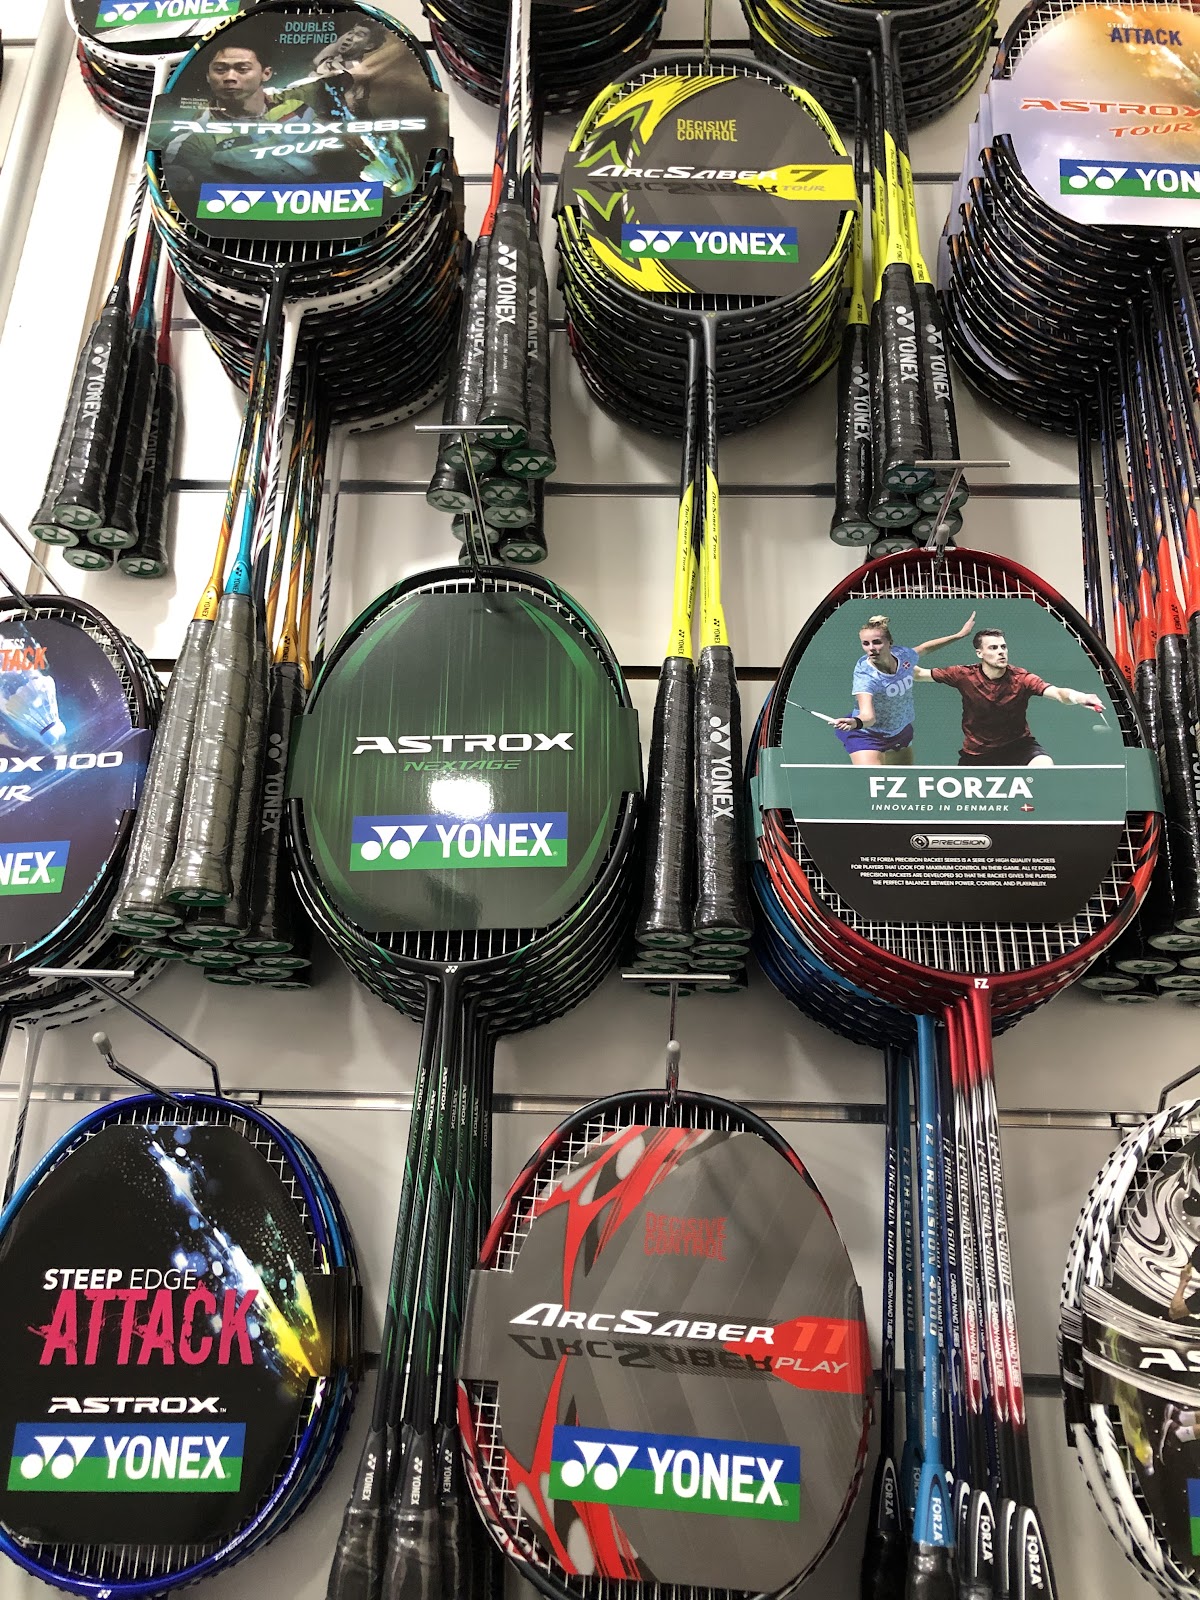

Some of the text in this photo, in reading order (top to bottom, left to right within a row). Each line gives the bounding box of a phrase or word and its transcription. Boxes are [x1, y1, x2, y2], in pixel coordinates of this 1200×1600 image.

[155, 0, 230, 18] YONEX
[279, 33, 338, 45] REDEFINED
[285, 21, 335, 32] DOUBLES
[1108, 27, 1183, 46] ATTACK
[170, 119, 340, 135] ASTROX
[676, 118, 737, 132] DECISIVE
[676, 129, 738, 142] CONTROL
[1109, 123, 1194, 138] TOUR
[250, 137, 345, 160] TOUR
[782, 184, 826, 193] TOUR
[789, 168, 829, 183] 7
[270, 187, 373, 215] YONEX
[690, 231, 788, 256] YONEX
[498, 278, 517, 326] YONEX
[898, 335, 920, 384] YONEX
[929, 354, 951, 402] YONEX
[82, 373, 106, 420] YONEX
[854, 395, 871, 441] YONEX
[1173, 614, 1182, 630] YONEX
[677, 638, 685, 655] YONEX
[351, 733, 575, 755] ASTROX
[54, 750, 124, 771] 100
[403, 760, 522, 772] NEXTAGE
[711, 755, 735, 820] YONEX
[869, 776, 908, 798] FZ
[261, 771, 285, 833] YONEX
[871, 804, 934, 812] INNOVATED
[956, 804, 1010, 812] DENMARK
[436, 823, 554, 859] YONEX
[974, 977, 989, 990] FZ
[417, 1067, 426, 1111] ASTROX
[440, 1067, 449, 1111] ASTROX
[888, 1165, 896, 1227] PRECISION
[943, 1137, 957, 1266] FZ PRECISION 6000
[645, 1211, 728, 1239] DECISIVE
[925, 1122, 938, 1337] FZ PRECISION 4000
[644, 1232, 728, 1262] CONTROL
[887, 1230, 895, 1265] 6000
[43, 1268, 198, 1290] STEEP EDGE
[950, 1273, 958, 1302] CARBON
[36, 1288, 259, 1365] ATTACK
[792, 1320, 849, 1355] 11
[774, 1355, 849, 1376] PLAY
[104, 1435, 230, 1479] YONEX
[361, 1472, 375, 1501] YONEX
[411, 1474, 422, 1506] YONEX
[443, 1465, 453, 1494] YONEX
[648, 1446, 785, 1507] YONEX
